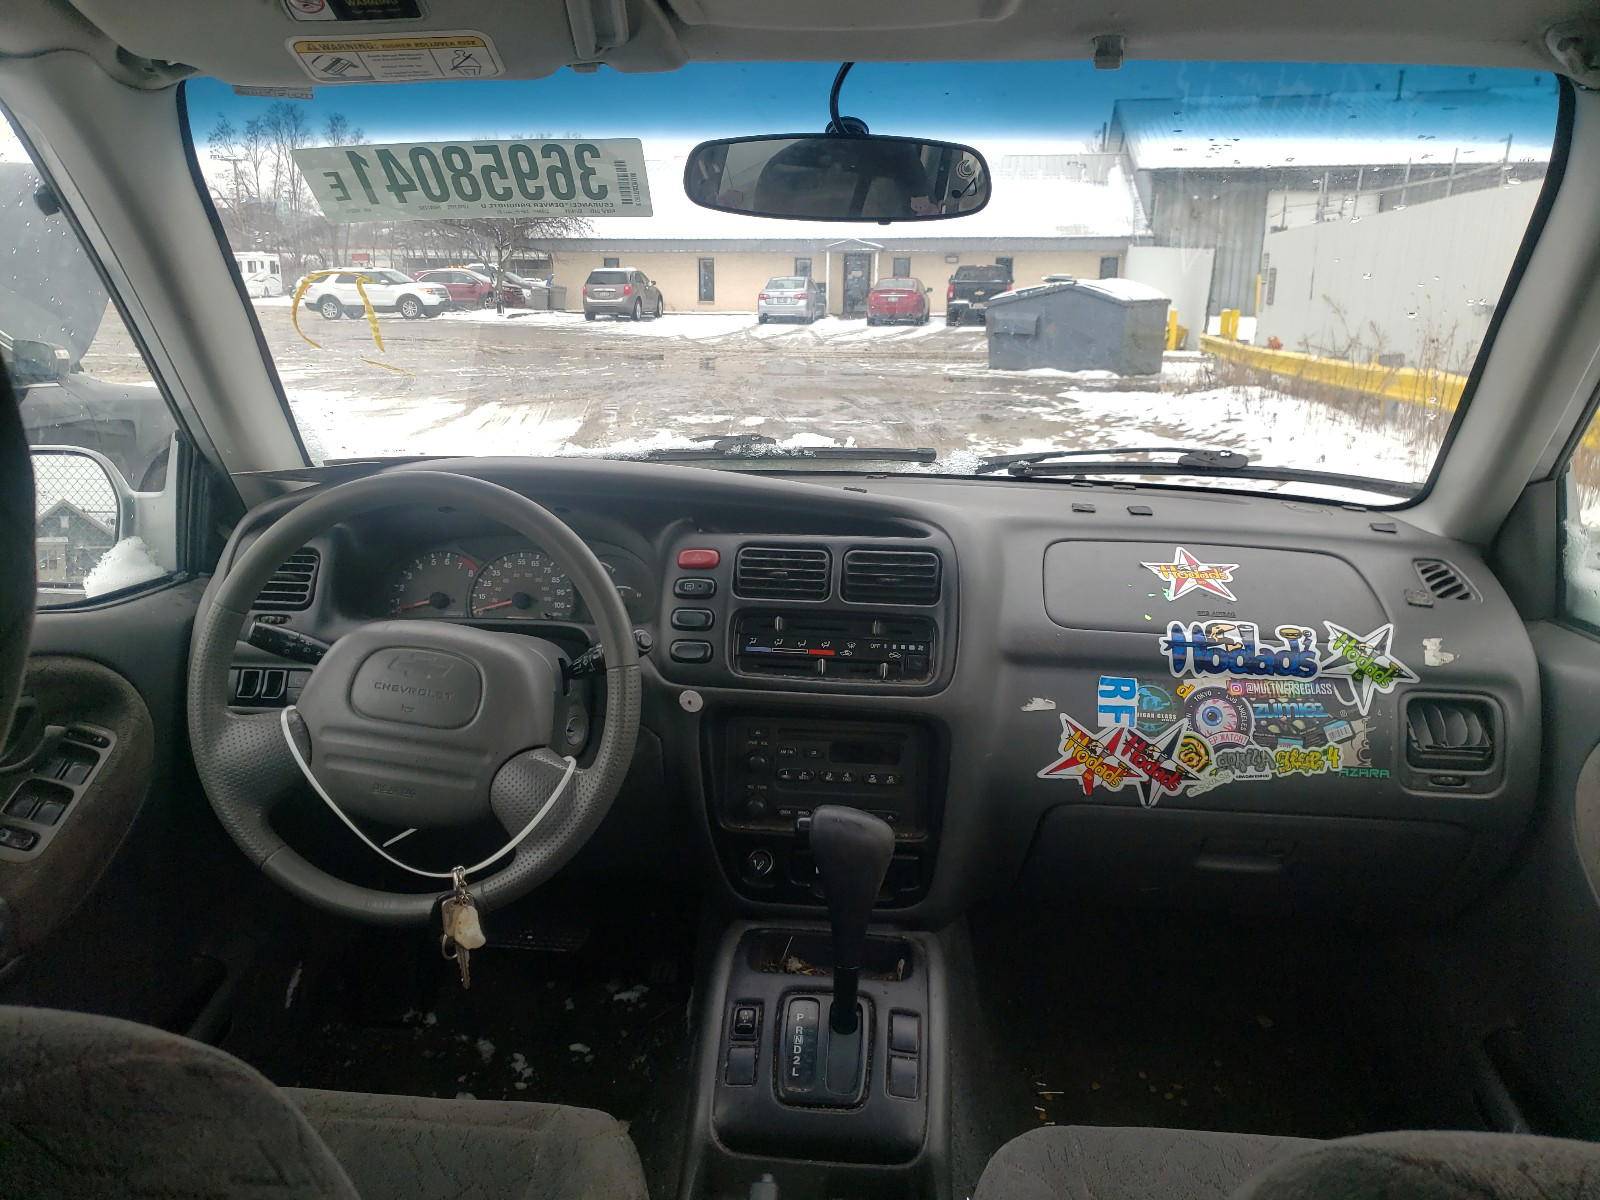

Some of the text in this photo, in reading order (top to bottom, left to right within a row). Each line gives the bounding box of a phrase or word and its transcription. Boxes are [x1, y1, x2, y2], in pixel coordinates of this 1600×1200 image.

[1193, 690, 1212, 702] TOKYO
[796, 1013, 805, 1021] P
[795, 1026, 803, 1034] R
[793, 1045, 801, 1053] D
[793, 1056, 801, 1065] 2
[792, 1068, 799, 1076] L
